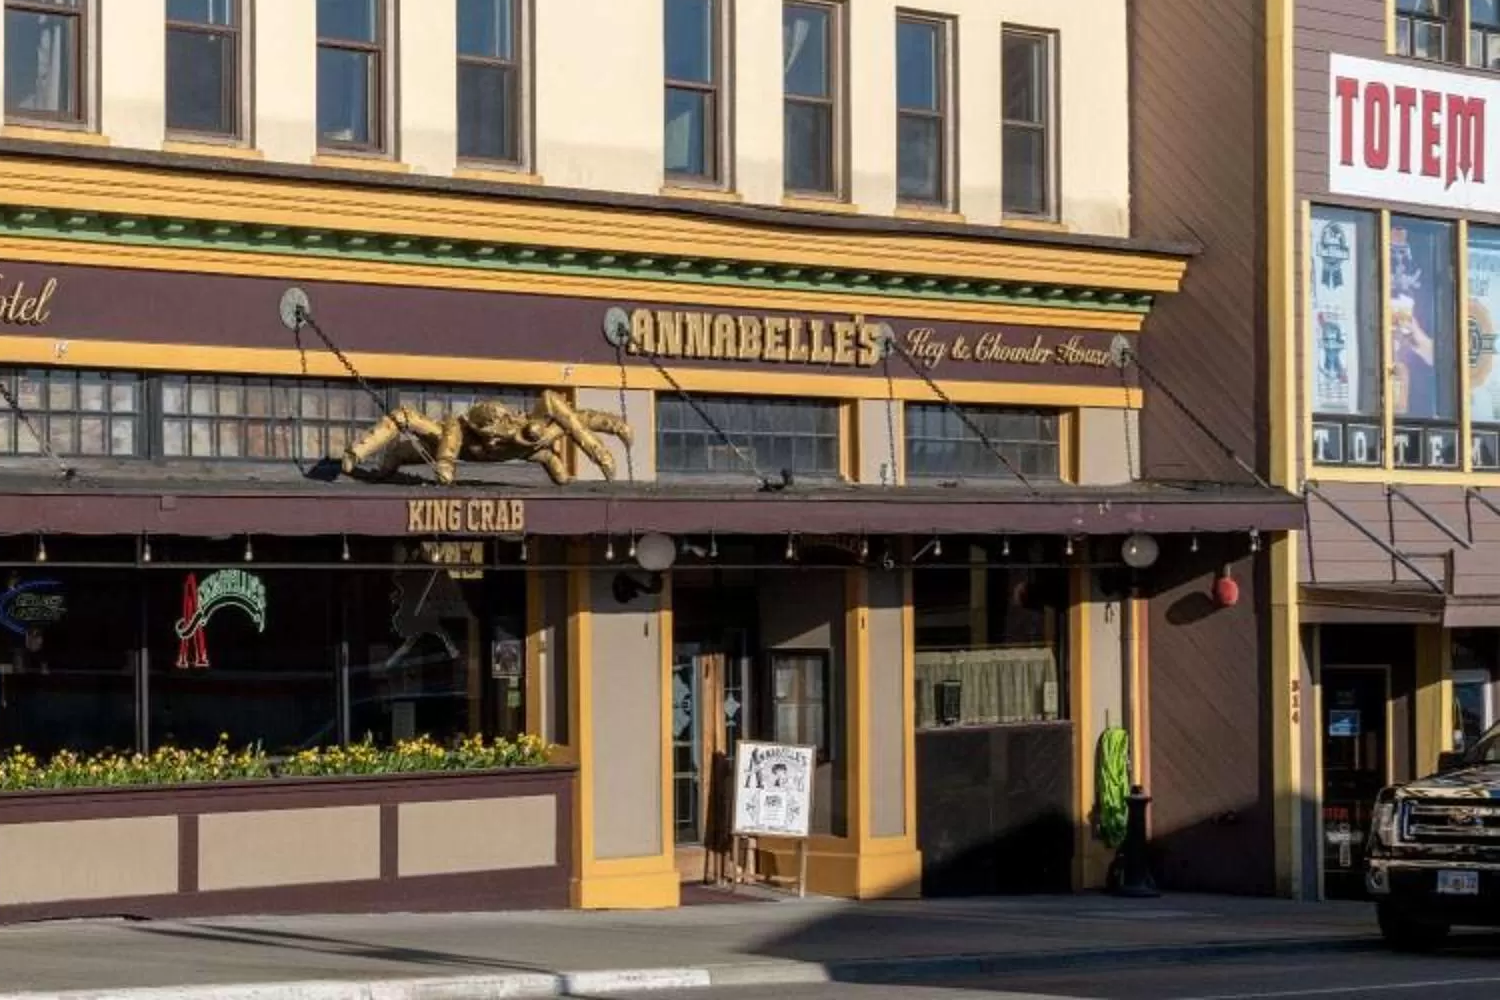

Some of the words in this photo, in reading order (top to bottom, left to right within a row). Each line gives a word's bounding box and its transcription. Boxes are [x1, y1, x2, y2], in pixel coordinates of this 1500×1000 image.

[1335, 75, 1487, 191] TOTEM
[627, 308, 881, 366] ANNABELLE'S
[975, 331, 1052, 363] Chowder
[407, 499, 462, 532] KING
[467, 499, 526, 532] CRAB
